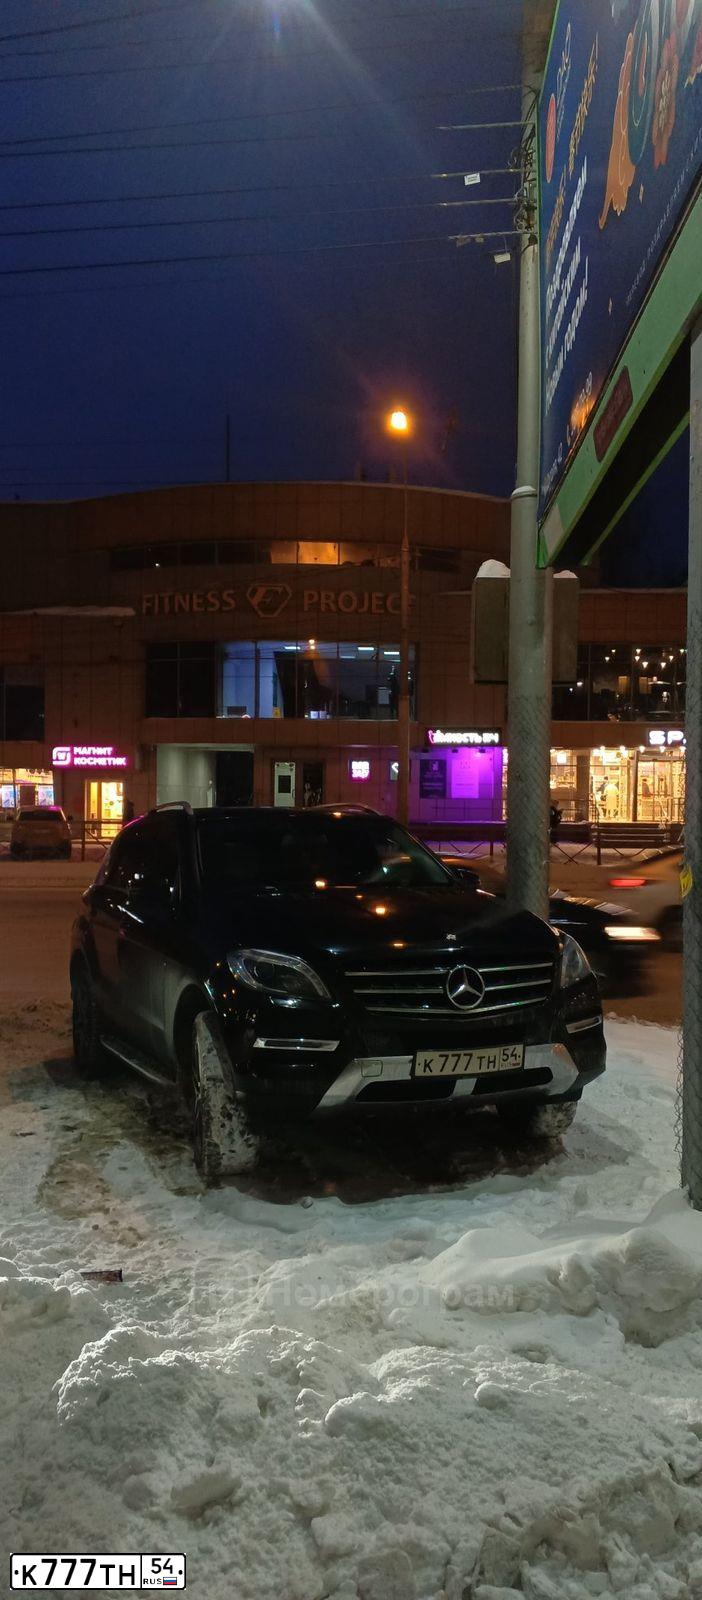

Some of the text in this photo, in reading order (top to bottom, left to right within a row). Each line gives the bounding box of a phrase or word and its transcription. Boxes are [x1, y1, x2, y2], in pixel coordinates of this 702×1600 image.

[141, 590, 236, 615] FITNESS
[649, 730, 687, 745] SP
[73, 746, 113, 756] МАГНИТ
[73, 757, 127, 766] КОСМЕТИК
[501, 1047, 517, 1062] 54
